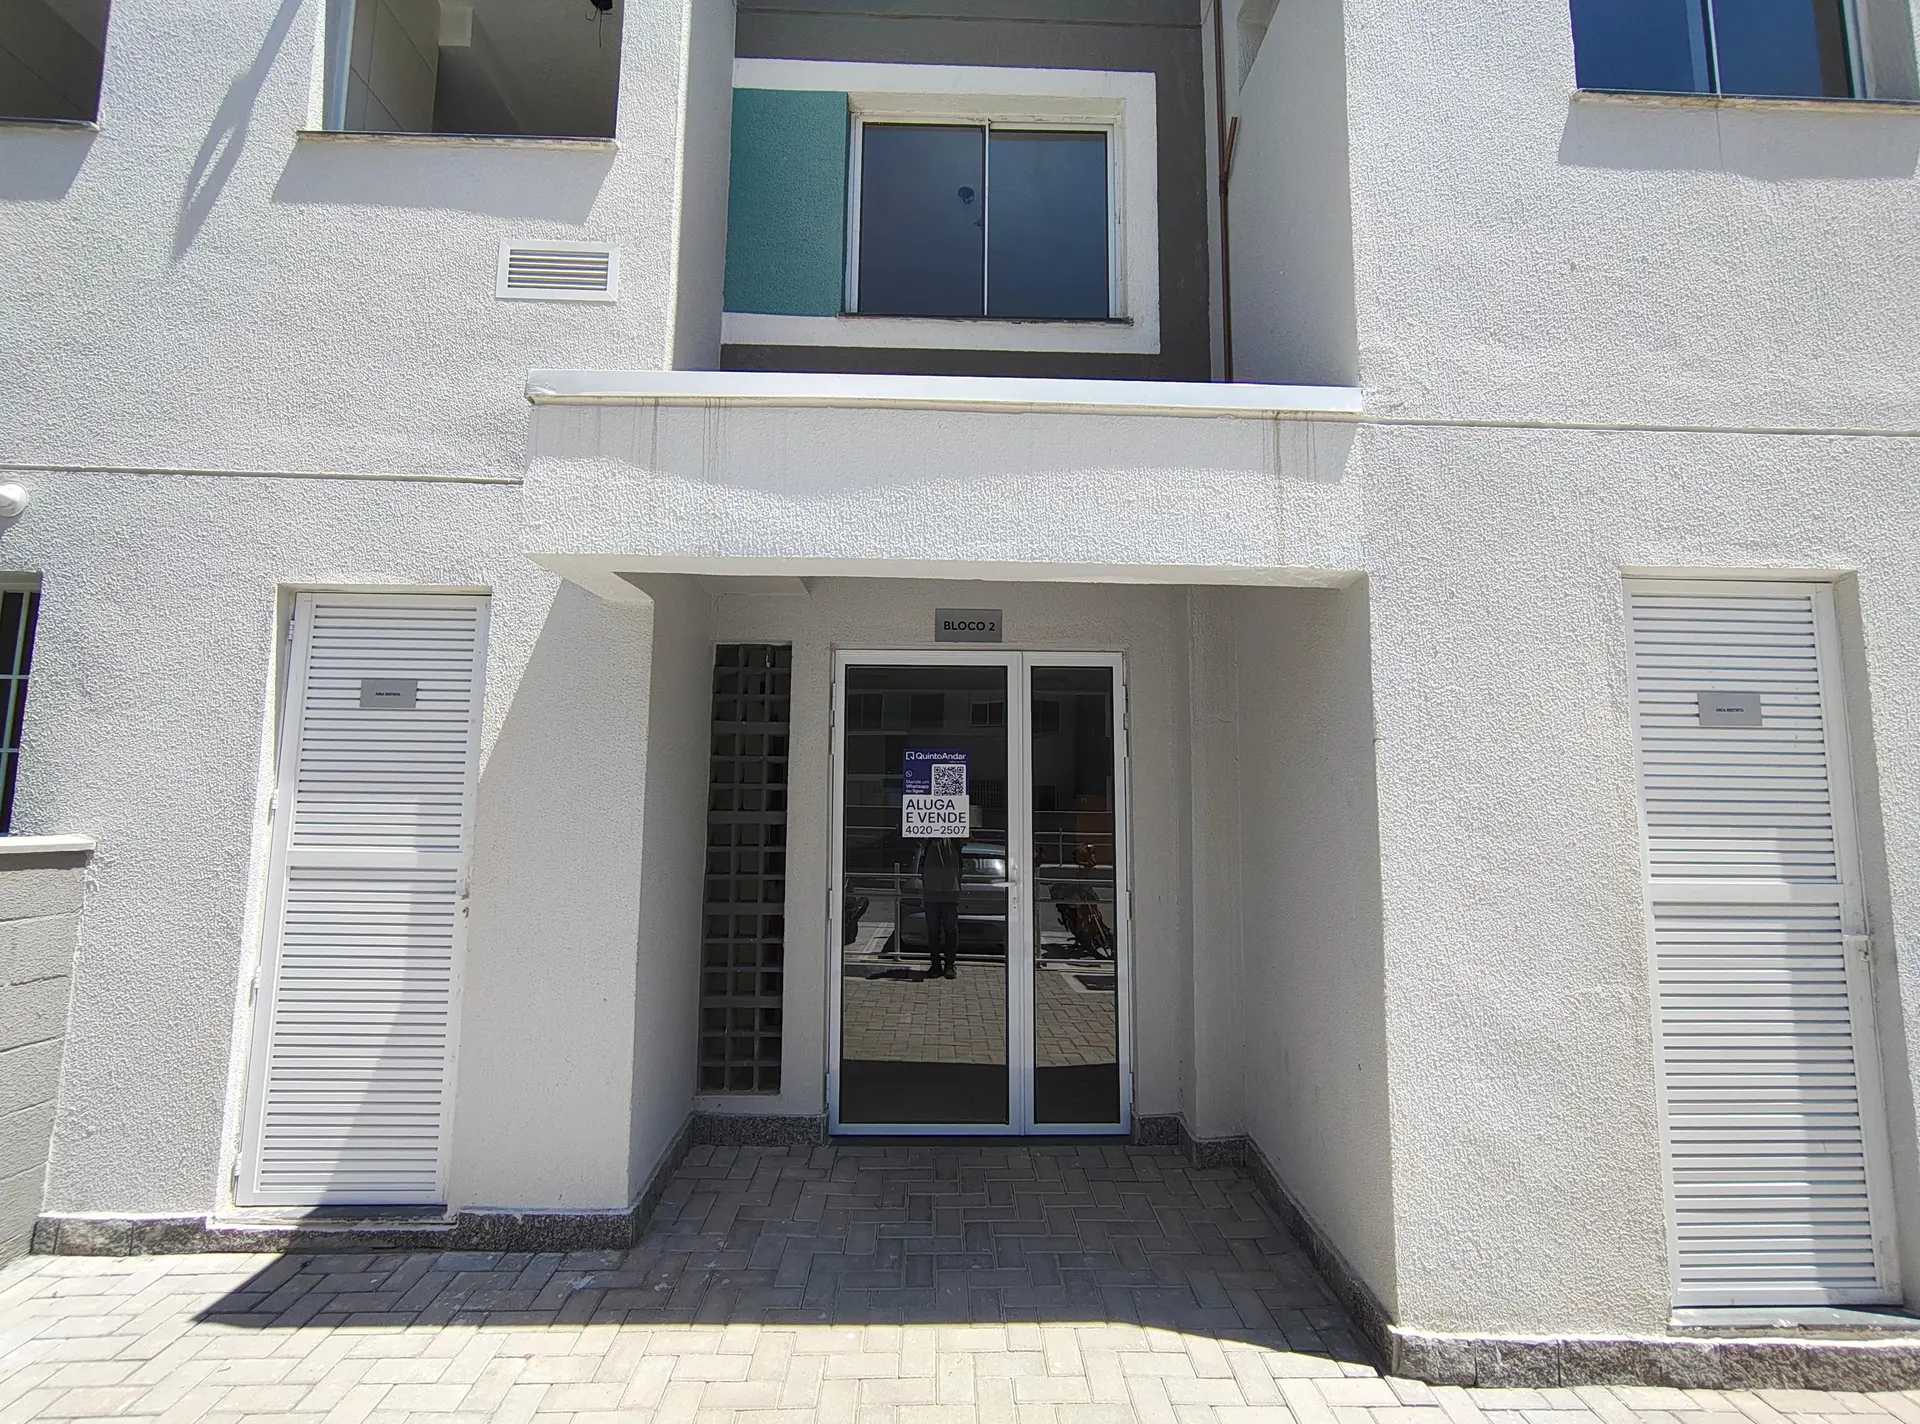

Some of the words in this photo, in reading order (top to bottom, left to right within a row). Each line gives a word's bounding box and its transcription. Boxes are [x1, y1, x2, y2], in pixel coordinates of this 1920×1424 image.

[943, 621, 986, 631] BLOCO
[988, 621, 996, 631] 2
[915, 752, 967, 760] QuintoAndar
[905, 799, 956, 810] ALUGA
[906, 812, 914, 823] E
[917, 812, 967, 823] VENDE
[905, 825, 967, 835] 4020-2507
